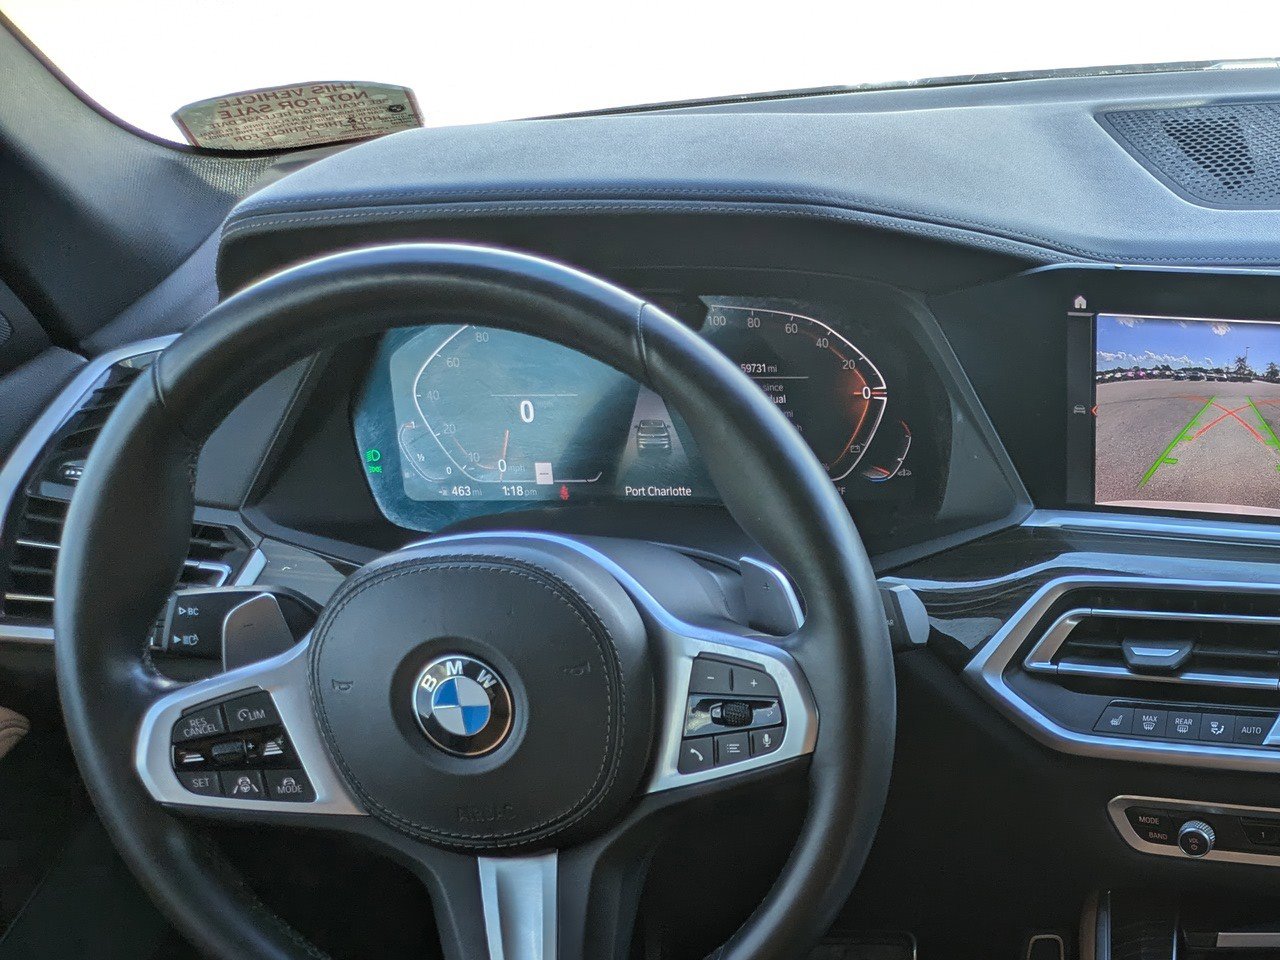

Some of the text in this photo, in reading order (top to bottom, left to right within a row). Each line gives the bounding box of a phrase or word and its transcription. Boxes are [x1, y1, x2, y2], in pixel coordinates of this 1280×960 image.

[475, 332, 489, 343] 80
[447, 358, 460, 367] 60
[708, 316, 870, 399] 100 80 60 40 20 0
[767, 365, 778, 373] mi
[763, 384, 784, 392] since
[427, 390, 440, 401] 40
[520, 400, 535, 423] 0
[443, 424, 456, 435] 20
[468, 453, 480, 462] 10
[498, 459, 507, 472] 0
[451, 486, 471, 496] 463
[501, 486, 537, 498] 1:18 pm
[625, 486, 692, 497] Port Charlotte
[187, 607, 199, 616] BC
[421, 660, 497, 693] BMW
[248, 709, 266, 720] LIM
[1142, 715, 1158, 723] MAX
[1174, 717, 1194, 726] REAR
[183, 724, 219, 738] CANCEL
[1241, 726, 1262, 735] AUTO
[192, 778, 210, 788] SET
[277, 784, 303, 794] MODE
[1138, 815, 1160, 825] MODE
